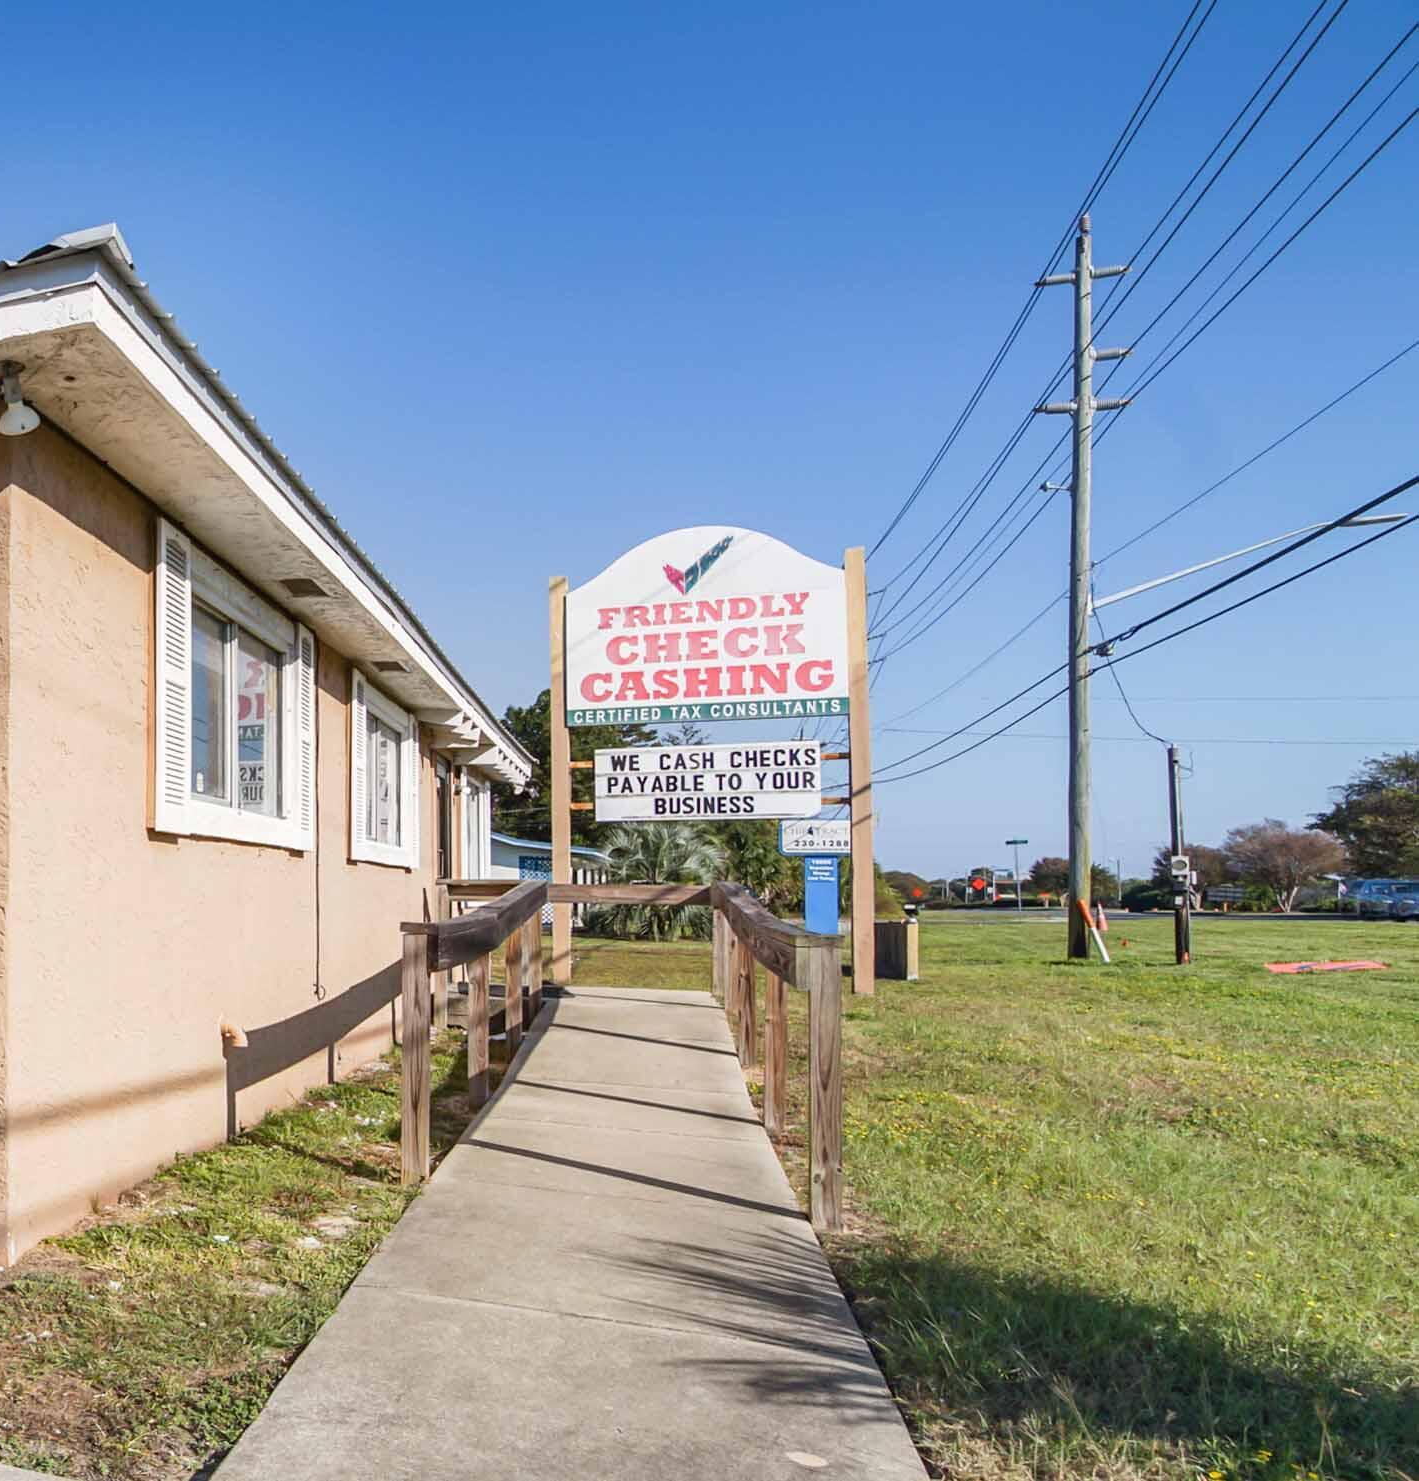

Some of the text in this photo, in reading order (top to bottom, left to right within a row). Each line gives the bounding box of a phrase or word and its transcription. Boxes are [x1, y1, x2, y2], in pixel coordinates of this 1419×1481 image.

[597, 592, 810, 630] FRIENDLY
[605, 623, 806, 666] CHECK
[581, 659, 834, 703] CASHING
[574, 699, 841, 724] CERTIFIED TAX CONSULTANTS
[611, 749, 817, 772] WE CASH CHECKS
[607, 771, 816, 794] PAYABLE TO YOUR
[654, 796, 755, 815] BUSINESS
